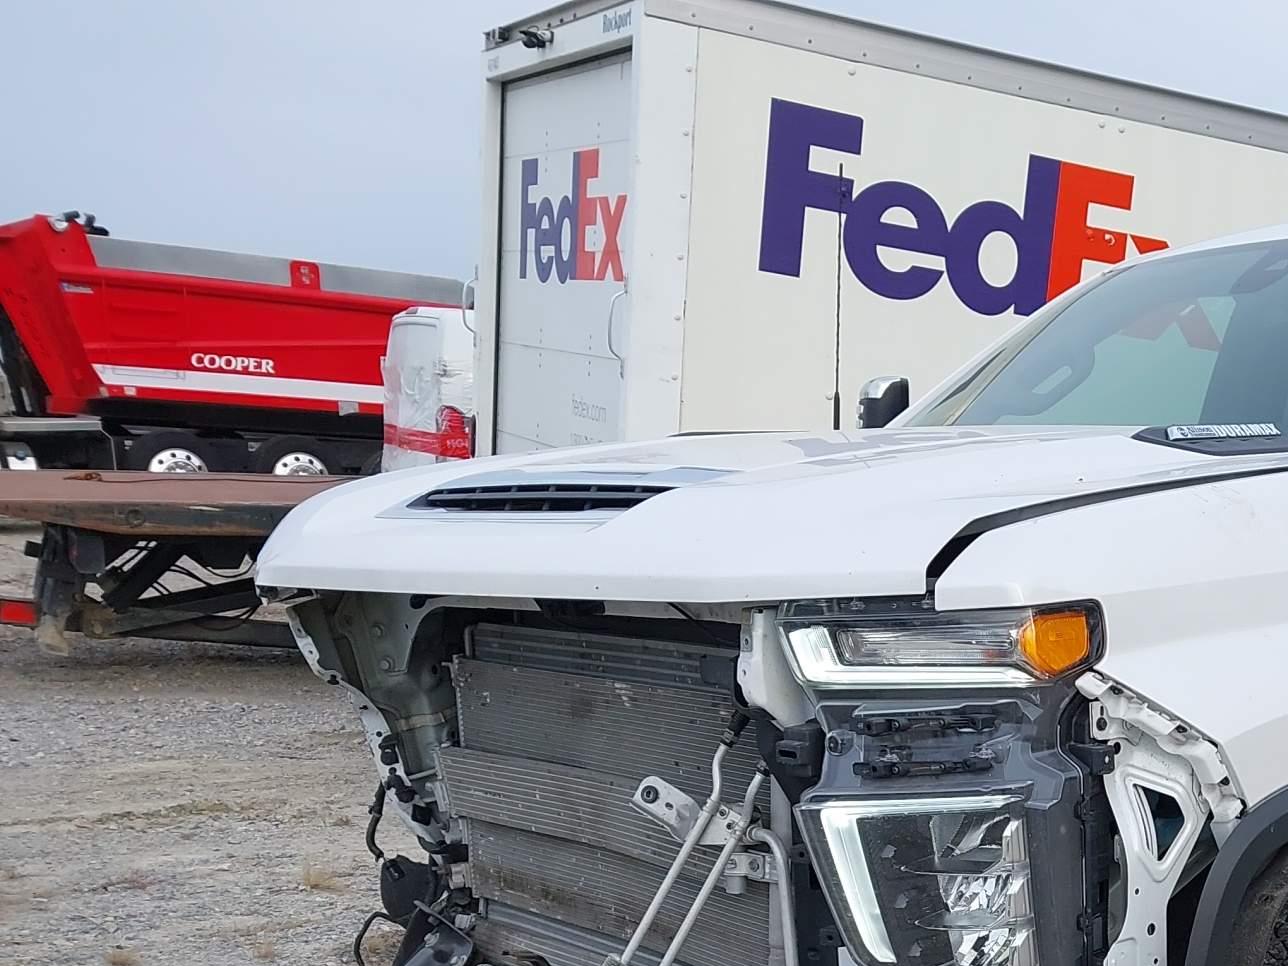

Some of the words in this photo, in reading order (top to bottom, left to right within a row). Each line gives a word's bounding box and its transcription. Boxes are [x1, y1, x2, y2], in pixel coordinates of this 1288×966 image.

[602, 8, 632, 33] Rockport
[519, 148, 627, 284] FedEx
[191, 352, 275, 374] COOPER
[1213, 423, 1281, 438] DURAMAX
